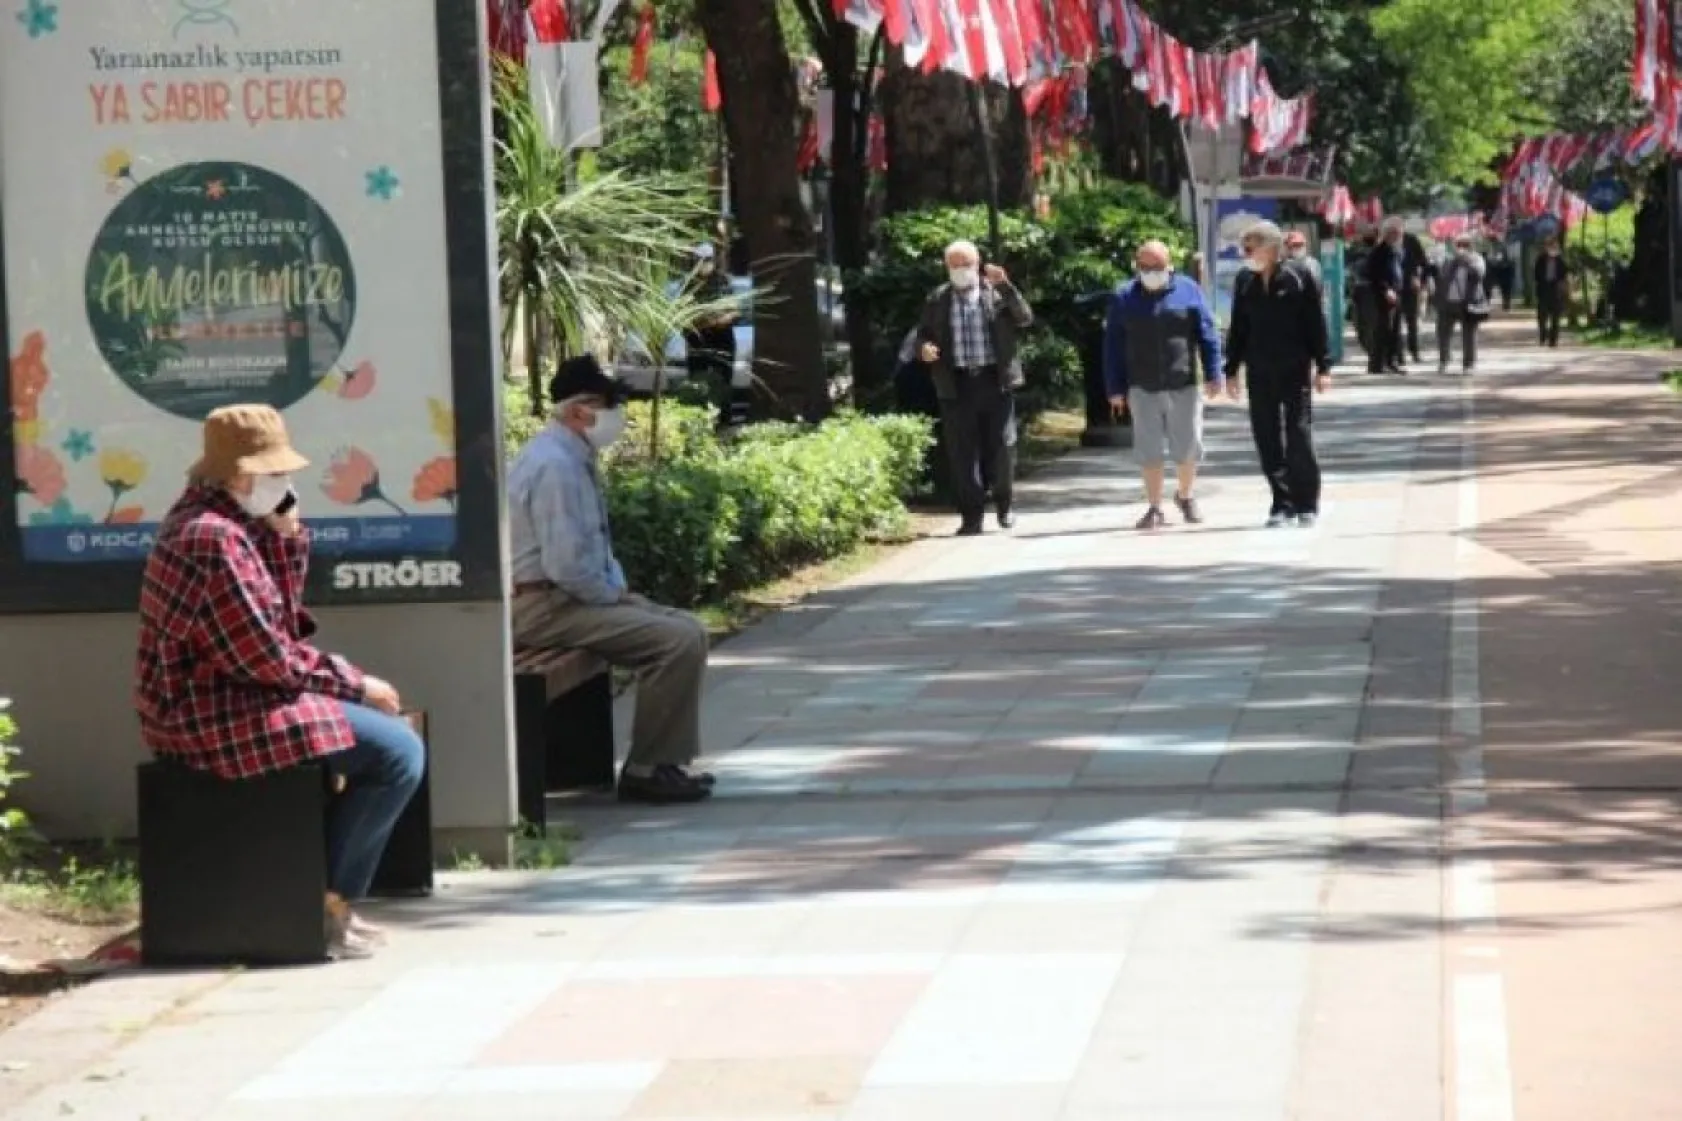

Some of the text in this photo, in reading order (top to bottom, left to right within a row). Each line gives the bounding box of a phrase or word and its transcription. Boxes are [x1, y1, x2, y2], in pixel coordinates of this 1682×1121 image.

[89, 78, 347, 127] YA SABIR ÇEKER
[334, 557, 462, 588] STRÖER
